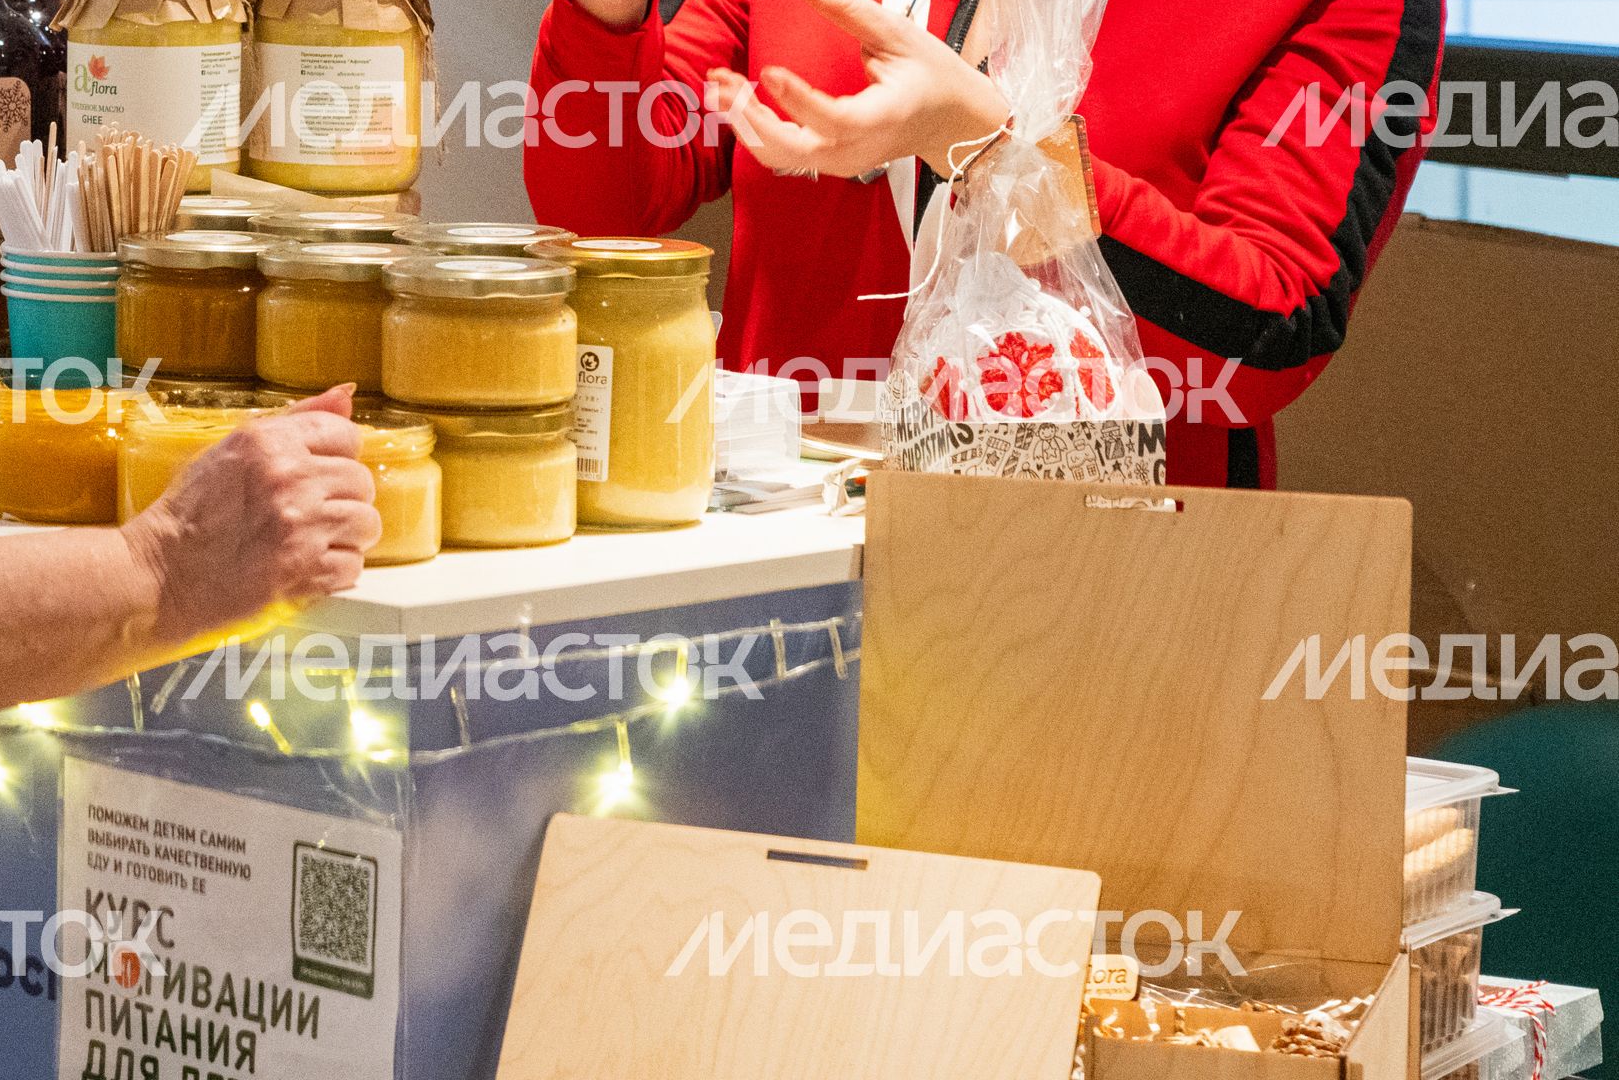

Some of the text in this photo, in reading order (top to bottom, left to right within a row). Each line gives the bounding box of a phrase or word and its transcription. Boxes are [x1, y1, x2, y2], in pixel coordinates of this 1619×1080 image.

[81, 114, 103, 125] GHEE
[99, 104, 125, 113] МАСЛО
[88, 803, 247, 855] ПОМОЖЕМ ДЕТЯМ САМИМ
[87, 851, 207, 895] ЕДУ И ГОТОВИТЬ ЕЕ
[88, 827, 252, 882] ВЫБИРАТЬ КАЧЕСТВЕННУЮ
[85, 886, 176, 949] КУРС
[85, 987, 257, 1075] ПИТАНИЯ
[81, 1038, 160, 1080] ДЛЯ
